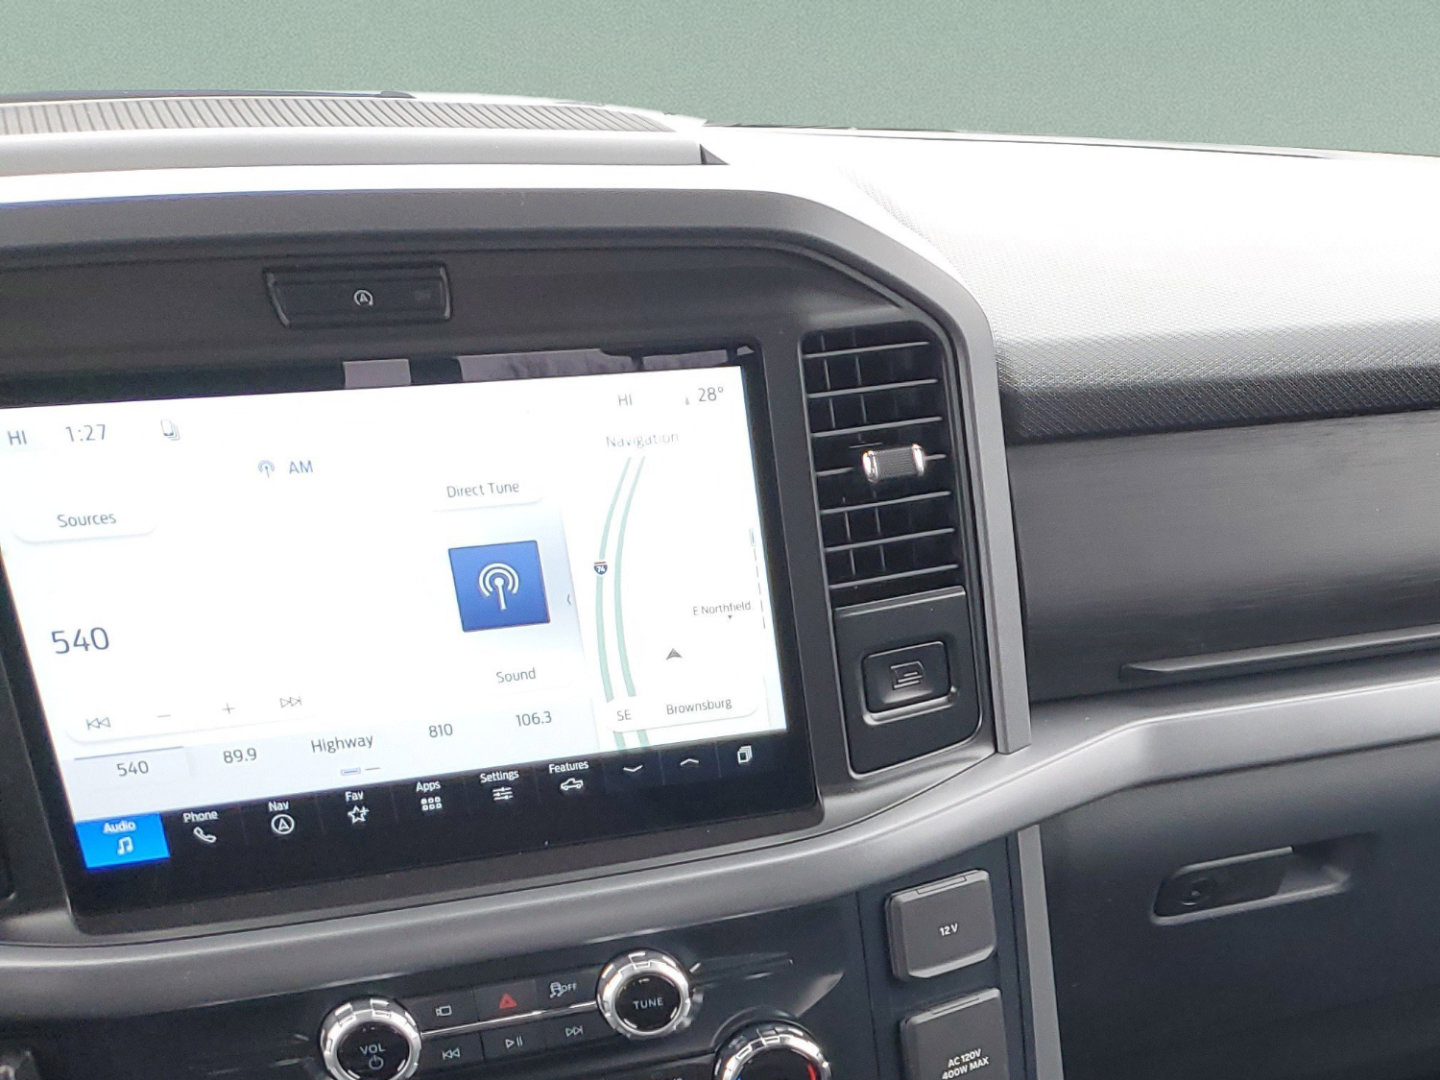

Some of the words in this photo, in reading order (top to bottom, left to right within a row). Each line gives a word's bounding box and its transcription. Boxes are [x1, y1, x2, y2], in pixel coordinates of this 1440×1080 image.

[617, 393, 633, 407] HI
[7, 430, 28, 446] HI
[65, 424, 107, 443] 1:27
[606, 433, 679, 449] Navigation
[288, 459, 314, 475] AM
[446, 482, 485, 498] Direct
[487, 480, 520, 496] Tune
[57, 511, 117, 528] Sources
[693, 605, 700, 616] E
[701, 601, 752, 616] Northfield
[51, 626, 110, 654] 540
[495, 667, 537, 683] Sound
[616, 709, 632, 722] SE
[665, 698, 733, 717] Brownsburg
[515, 711, 552, 728] 106.3
[428, 723, 453, 739] 810
[310, 734, 374, 755] Highway
[222, 747, 257, 765] 89.9
[116, 760, 150, 777] 540
[549, 760, 590, 775] Features
[479, 769, 520, 785] Settings
[415, 779, 441, 794] Apps
[344, 790, 365, 803] Fav
[268, 800, 290, 813] Nav
[182, 809, 218, 824] Phone
[103, 820, 136, 834] Audio
[561, 981, 577, 993] OFF
[633, 997, 664, 1011] TUNE
[359, 1043, 386, 1056] VOL
[948, 1057, 960, 1068] AC
[961, 1048, 982, 1064] 120V
[941, 1064, 968, 1080] 400W
[969, 1056, 990, 1072] MAX
